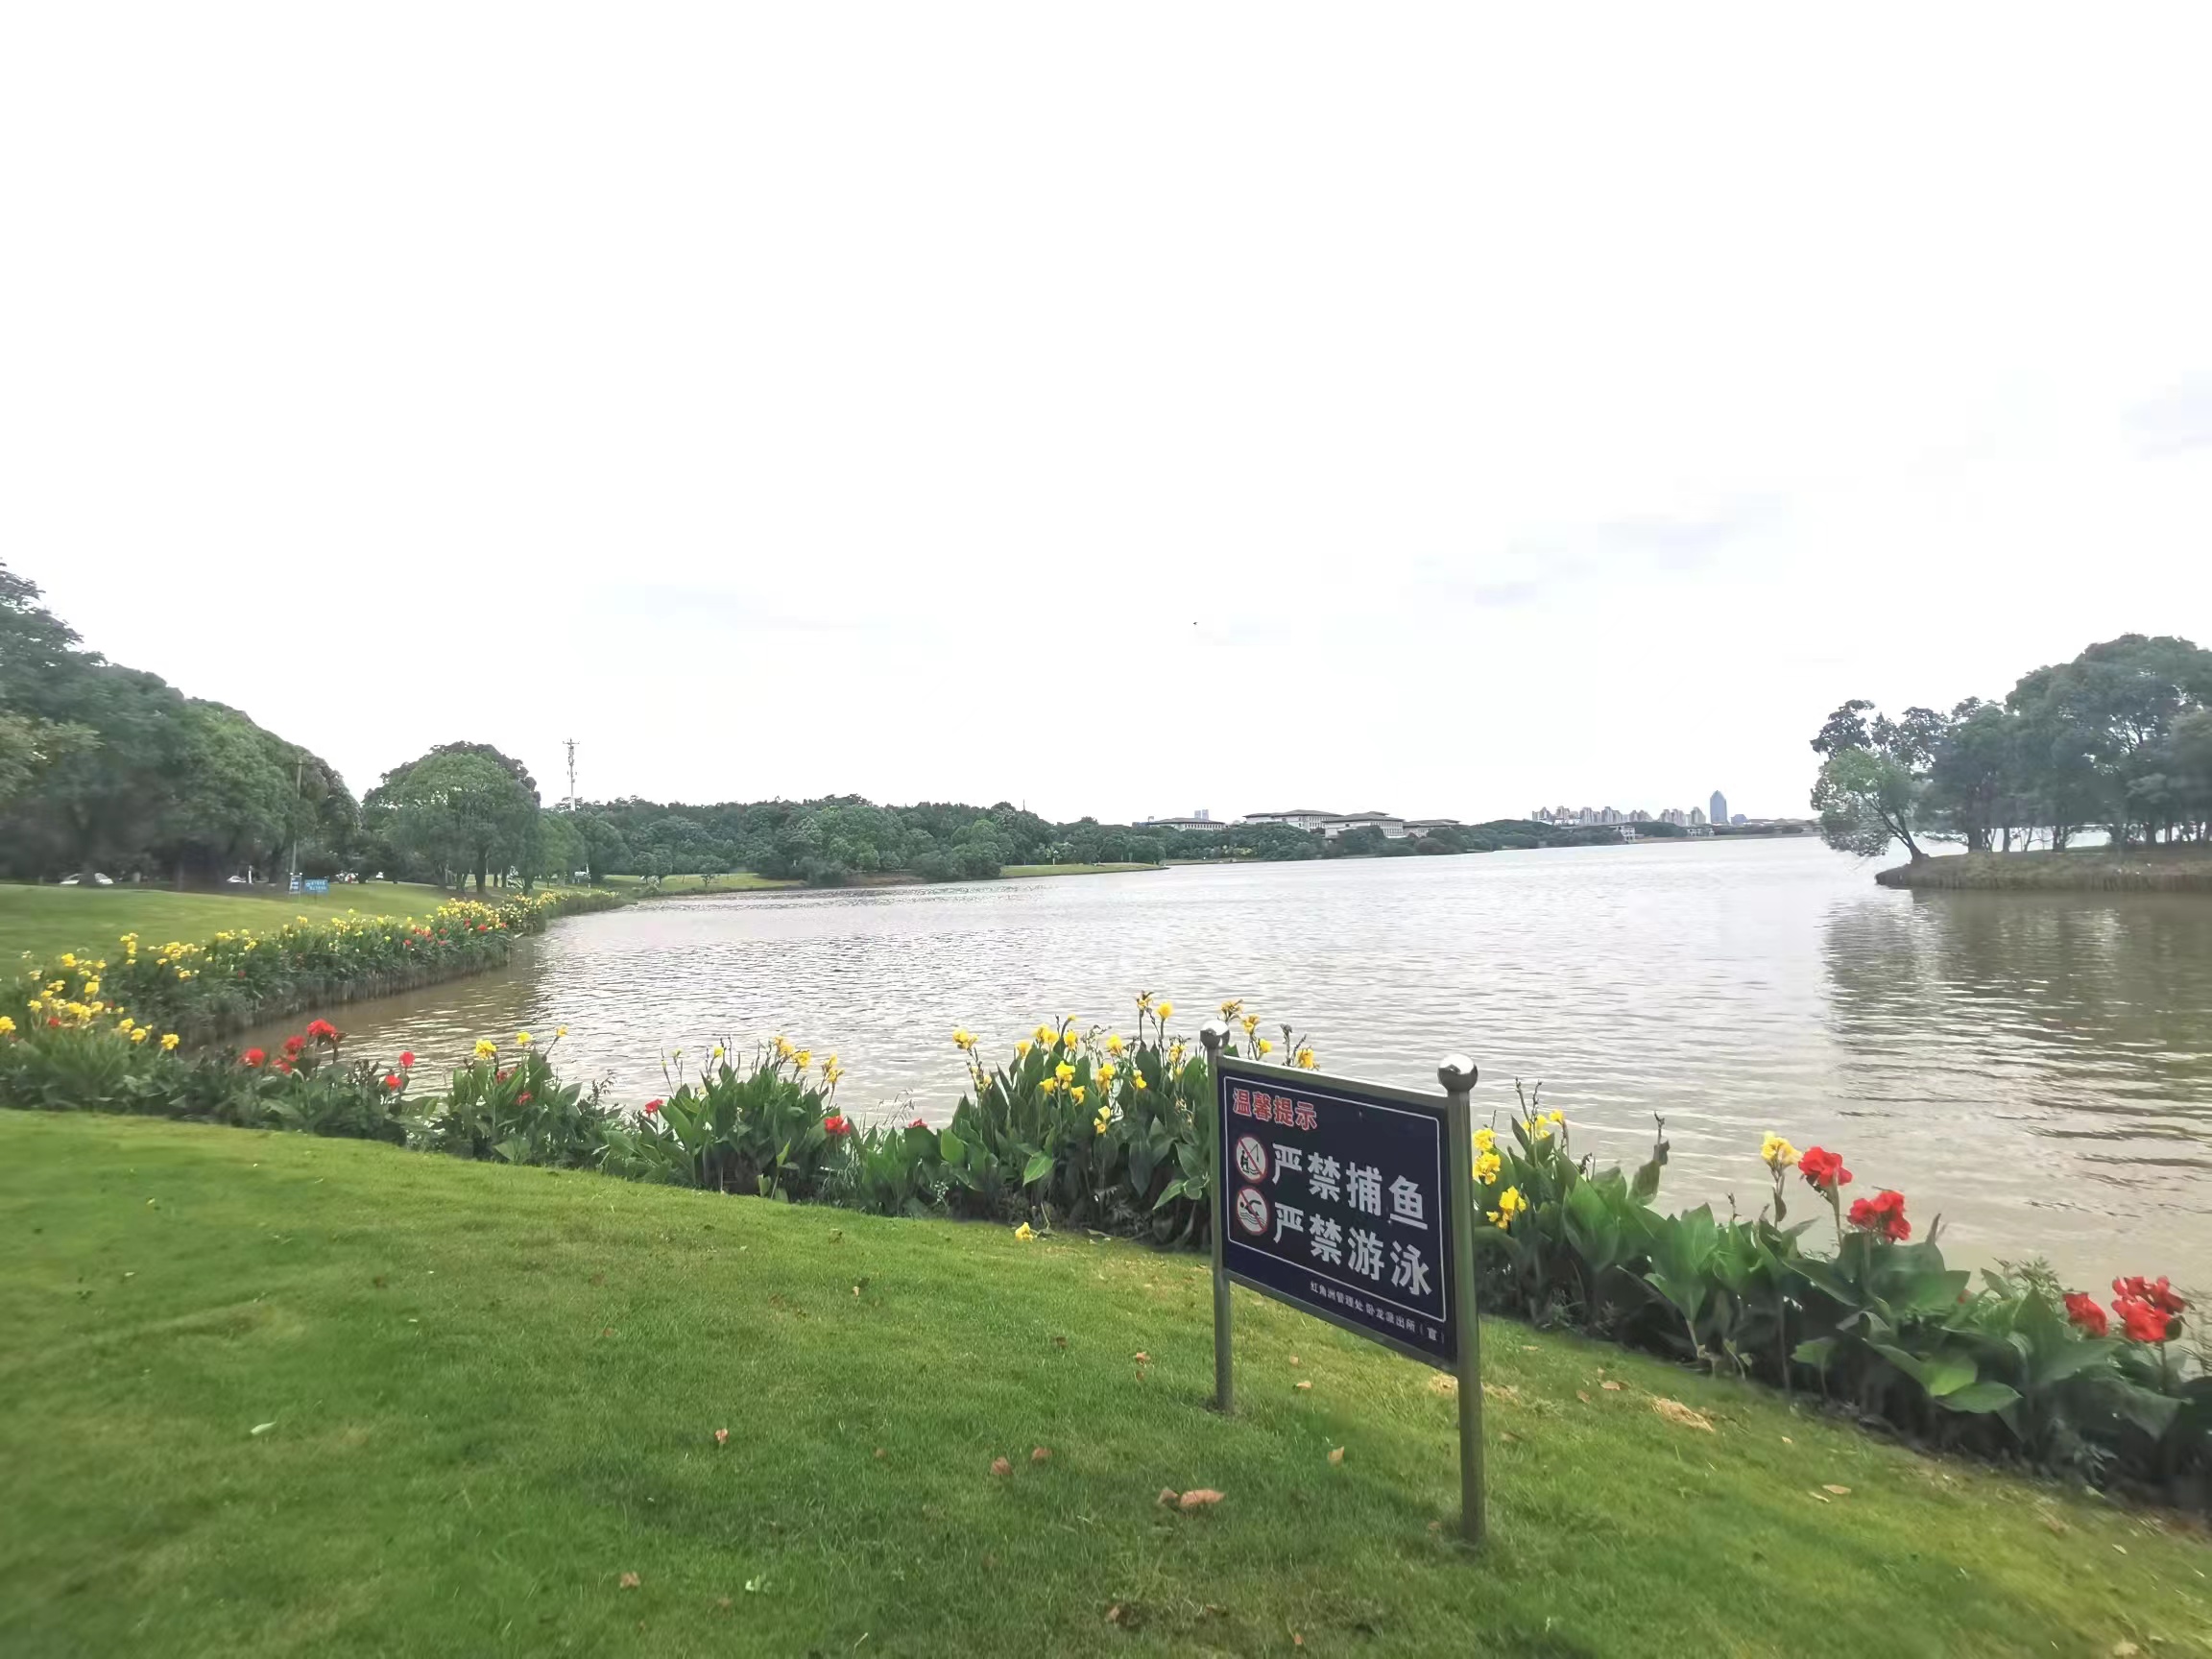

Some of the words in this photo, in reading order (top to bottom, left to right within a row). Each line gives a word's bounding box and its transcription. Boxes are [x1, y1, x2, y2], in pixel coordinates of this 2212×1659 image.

[1232, 1088, 1318, 1131] 温馨提示
[1272, 1142, 1429, 1231] 严禁捕鱼
[1273, 1202, 1433, 1297] 严禁游泳
